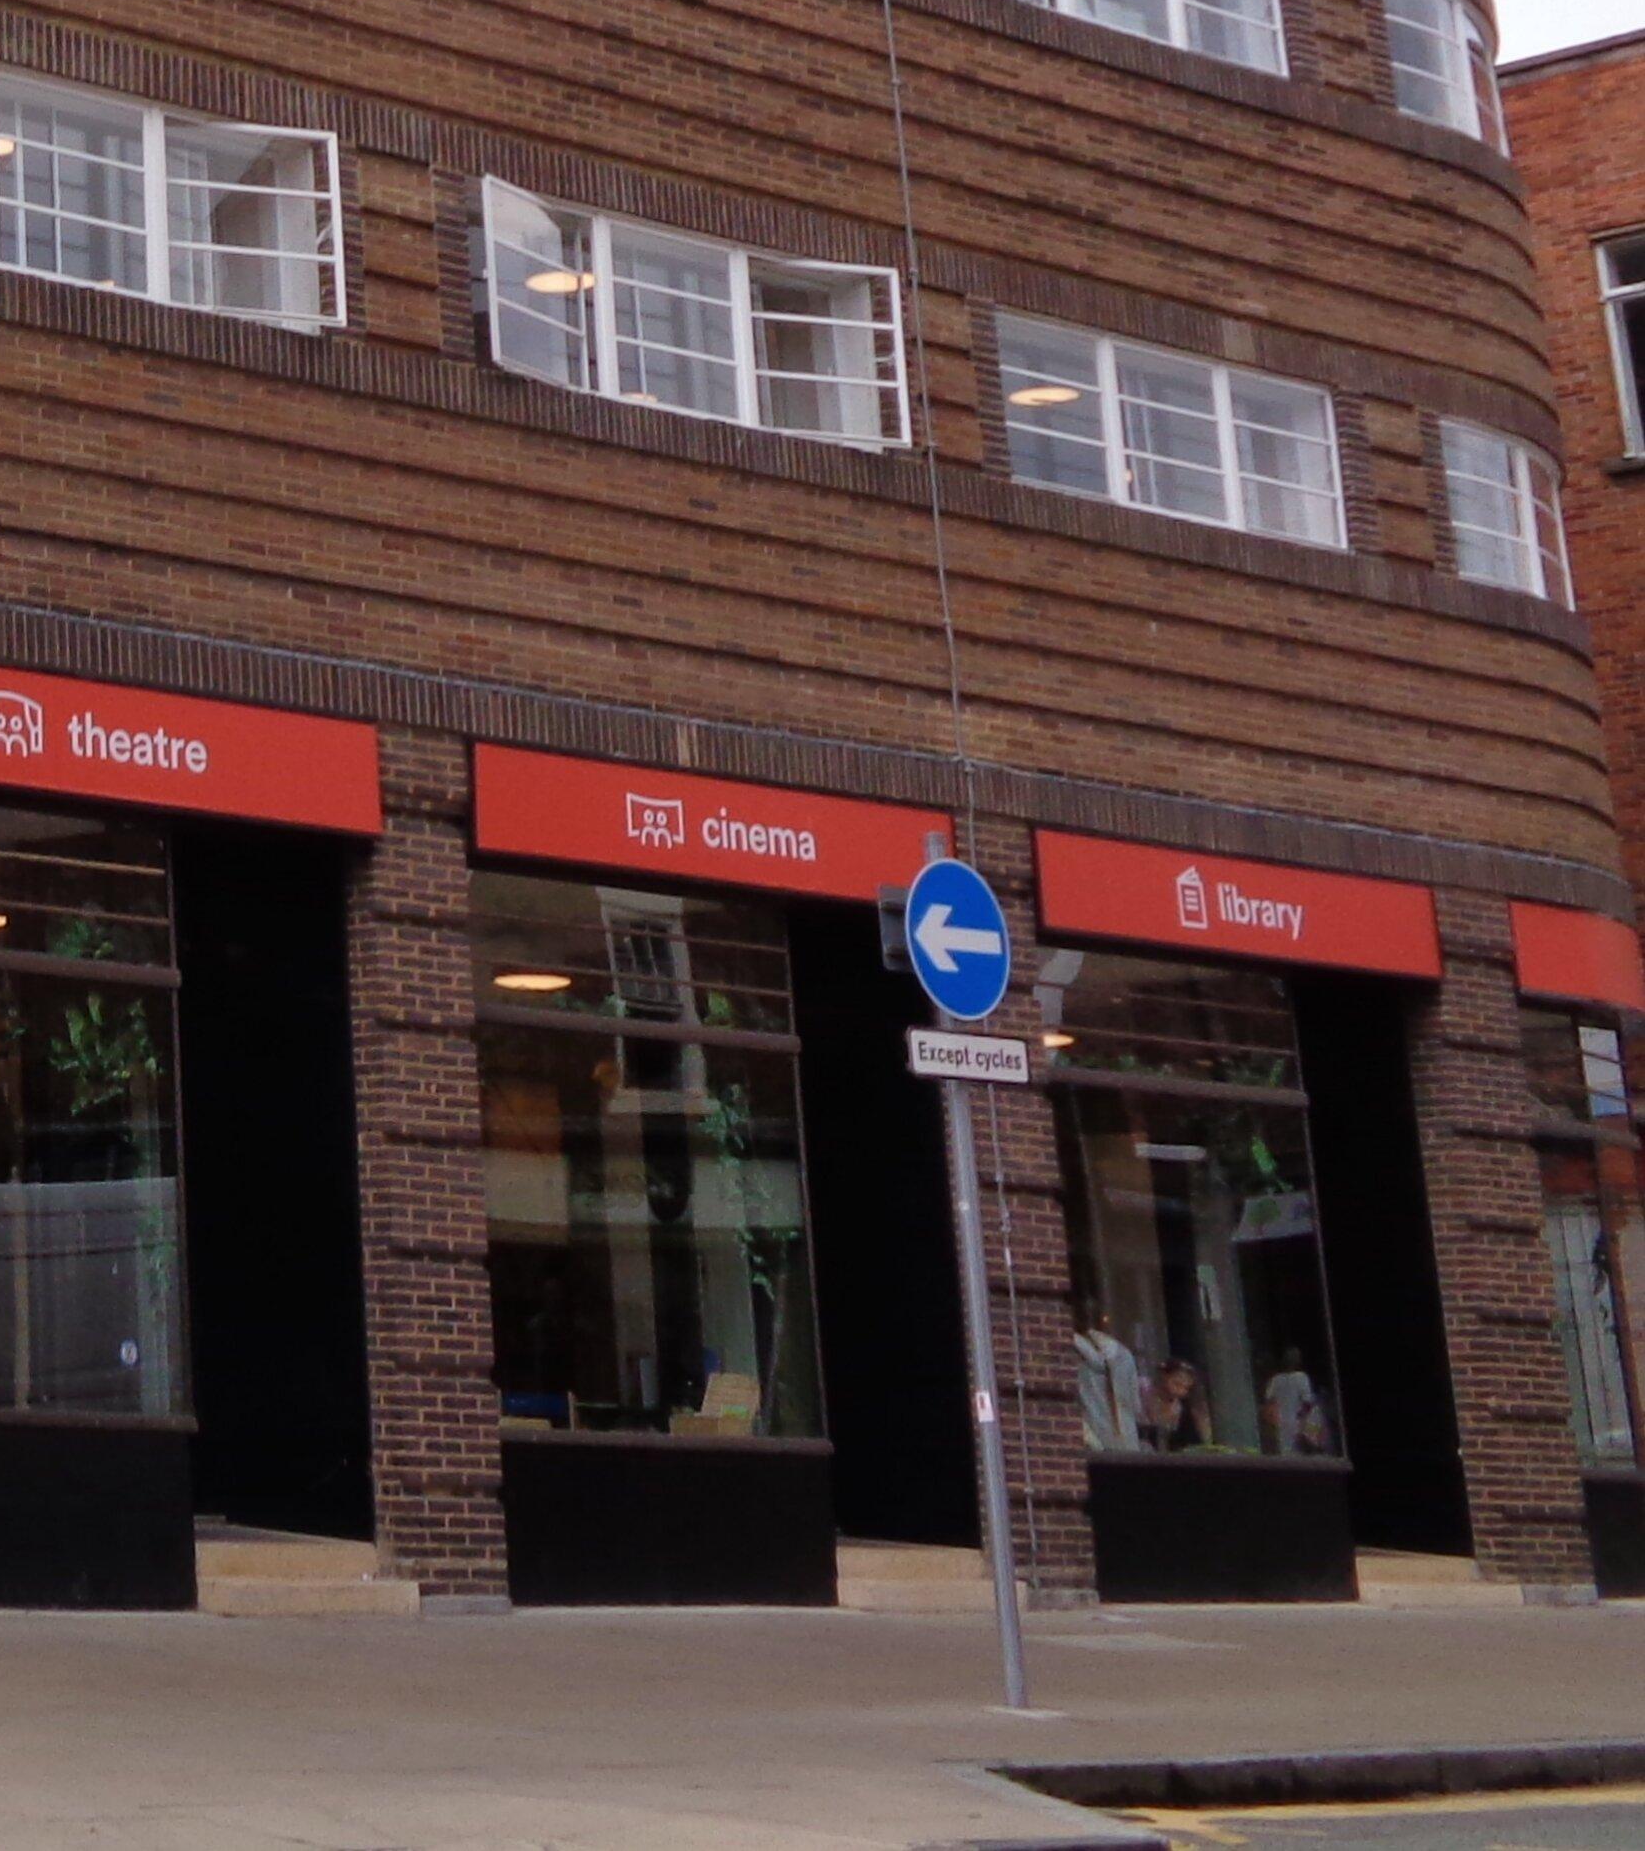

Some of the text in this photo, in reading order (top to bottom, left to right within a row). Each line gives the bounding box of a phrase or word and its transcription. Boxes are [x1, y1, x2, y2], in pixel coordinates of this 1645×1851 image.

[67, 711, 208, 774] theatre
[702, 805, 817, 862] cinema
[1217, 882, 1304, 941] library
[917, 1040, 1022, 1072] Except cycles
